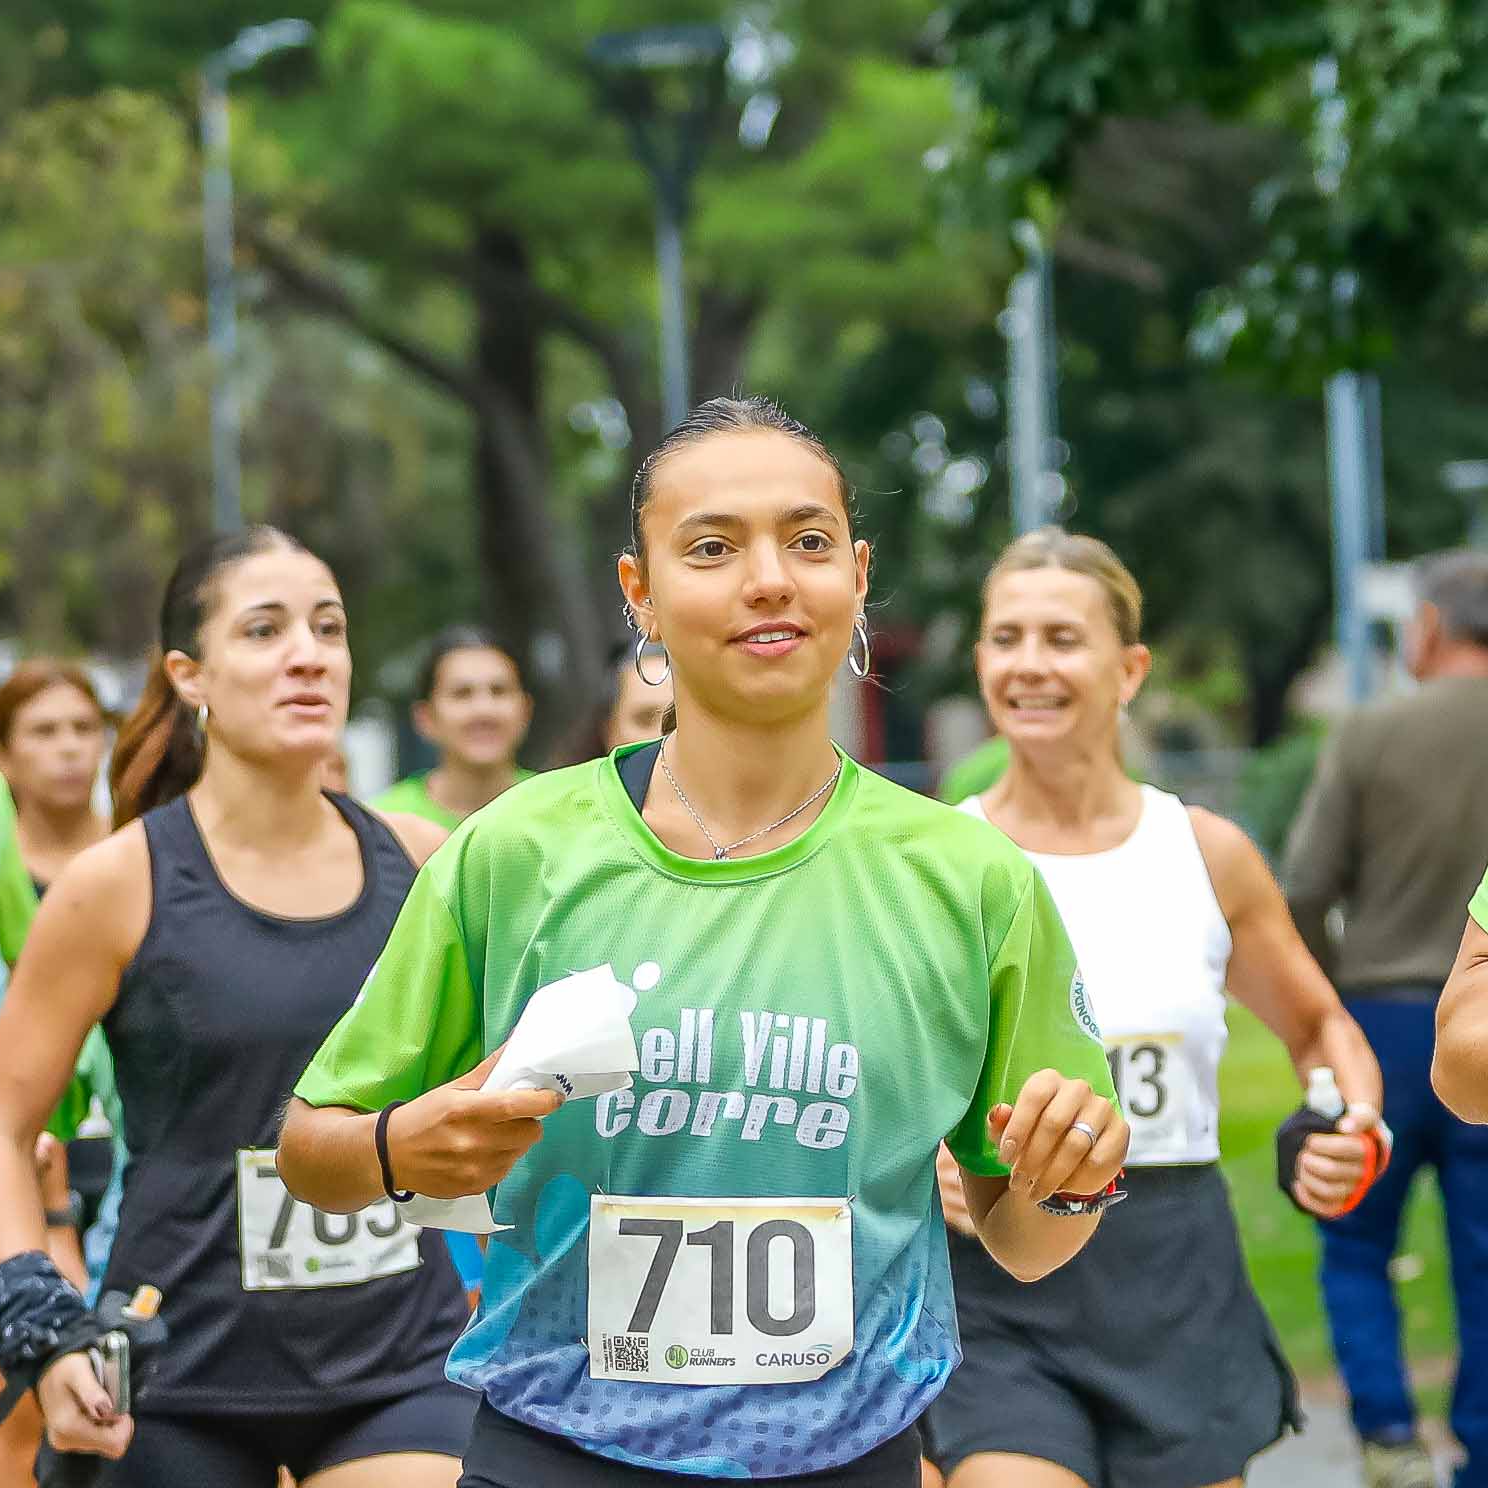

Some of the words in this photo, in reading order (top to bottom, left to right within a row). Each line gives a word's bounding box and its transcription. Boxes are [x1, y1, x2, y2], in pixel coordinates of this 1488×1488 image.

[739, 1010, 859, 1098] Ville
[595, 1088, 851, 1150] corre
[618, 1217, 816, 1337] 710
[690, 1348, 715, 1358] CLUB
[755, 1352, 830, 1367] CARUSO
